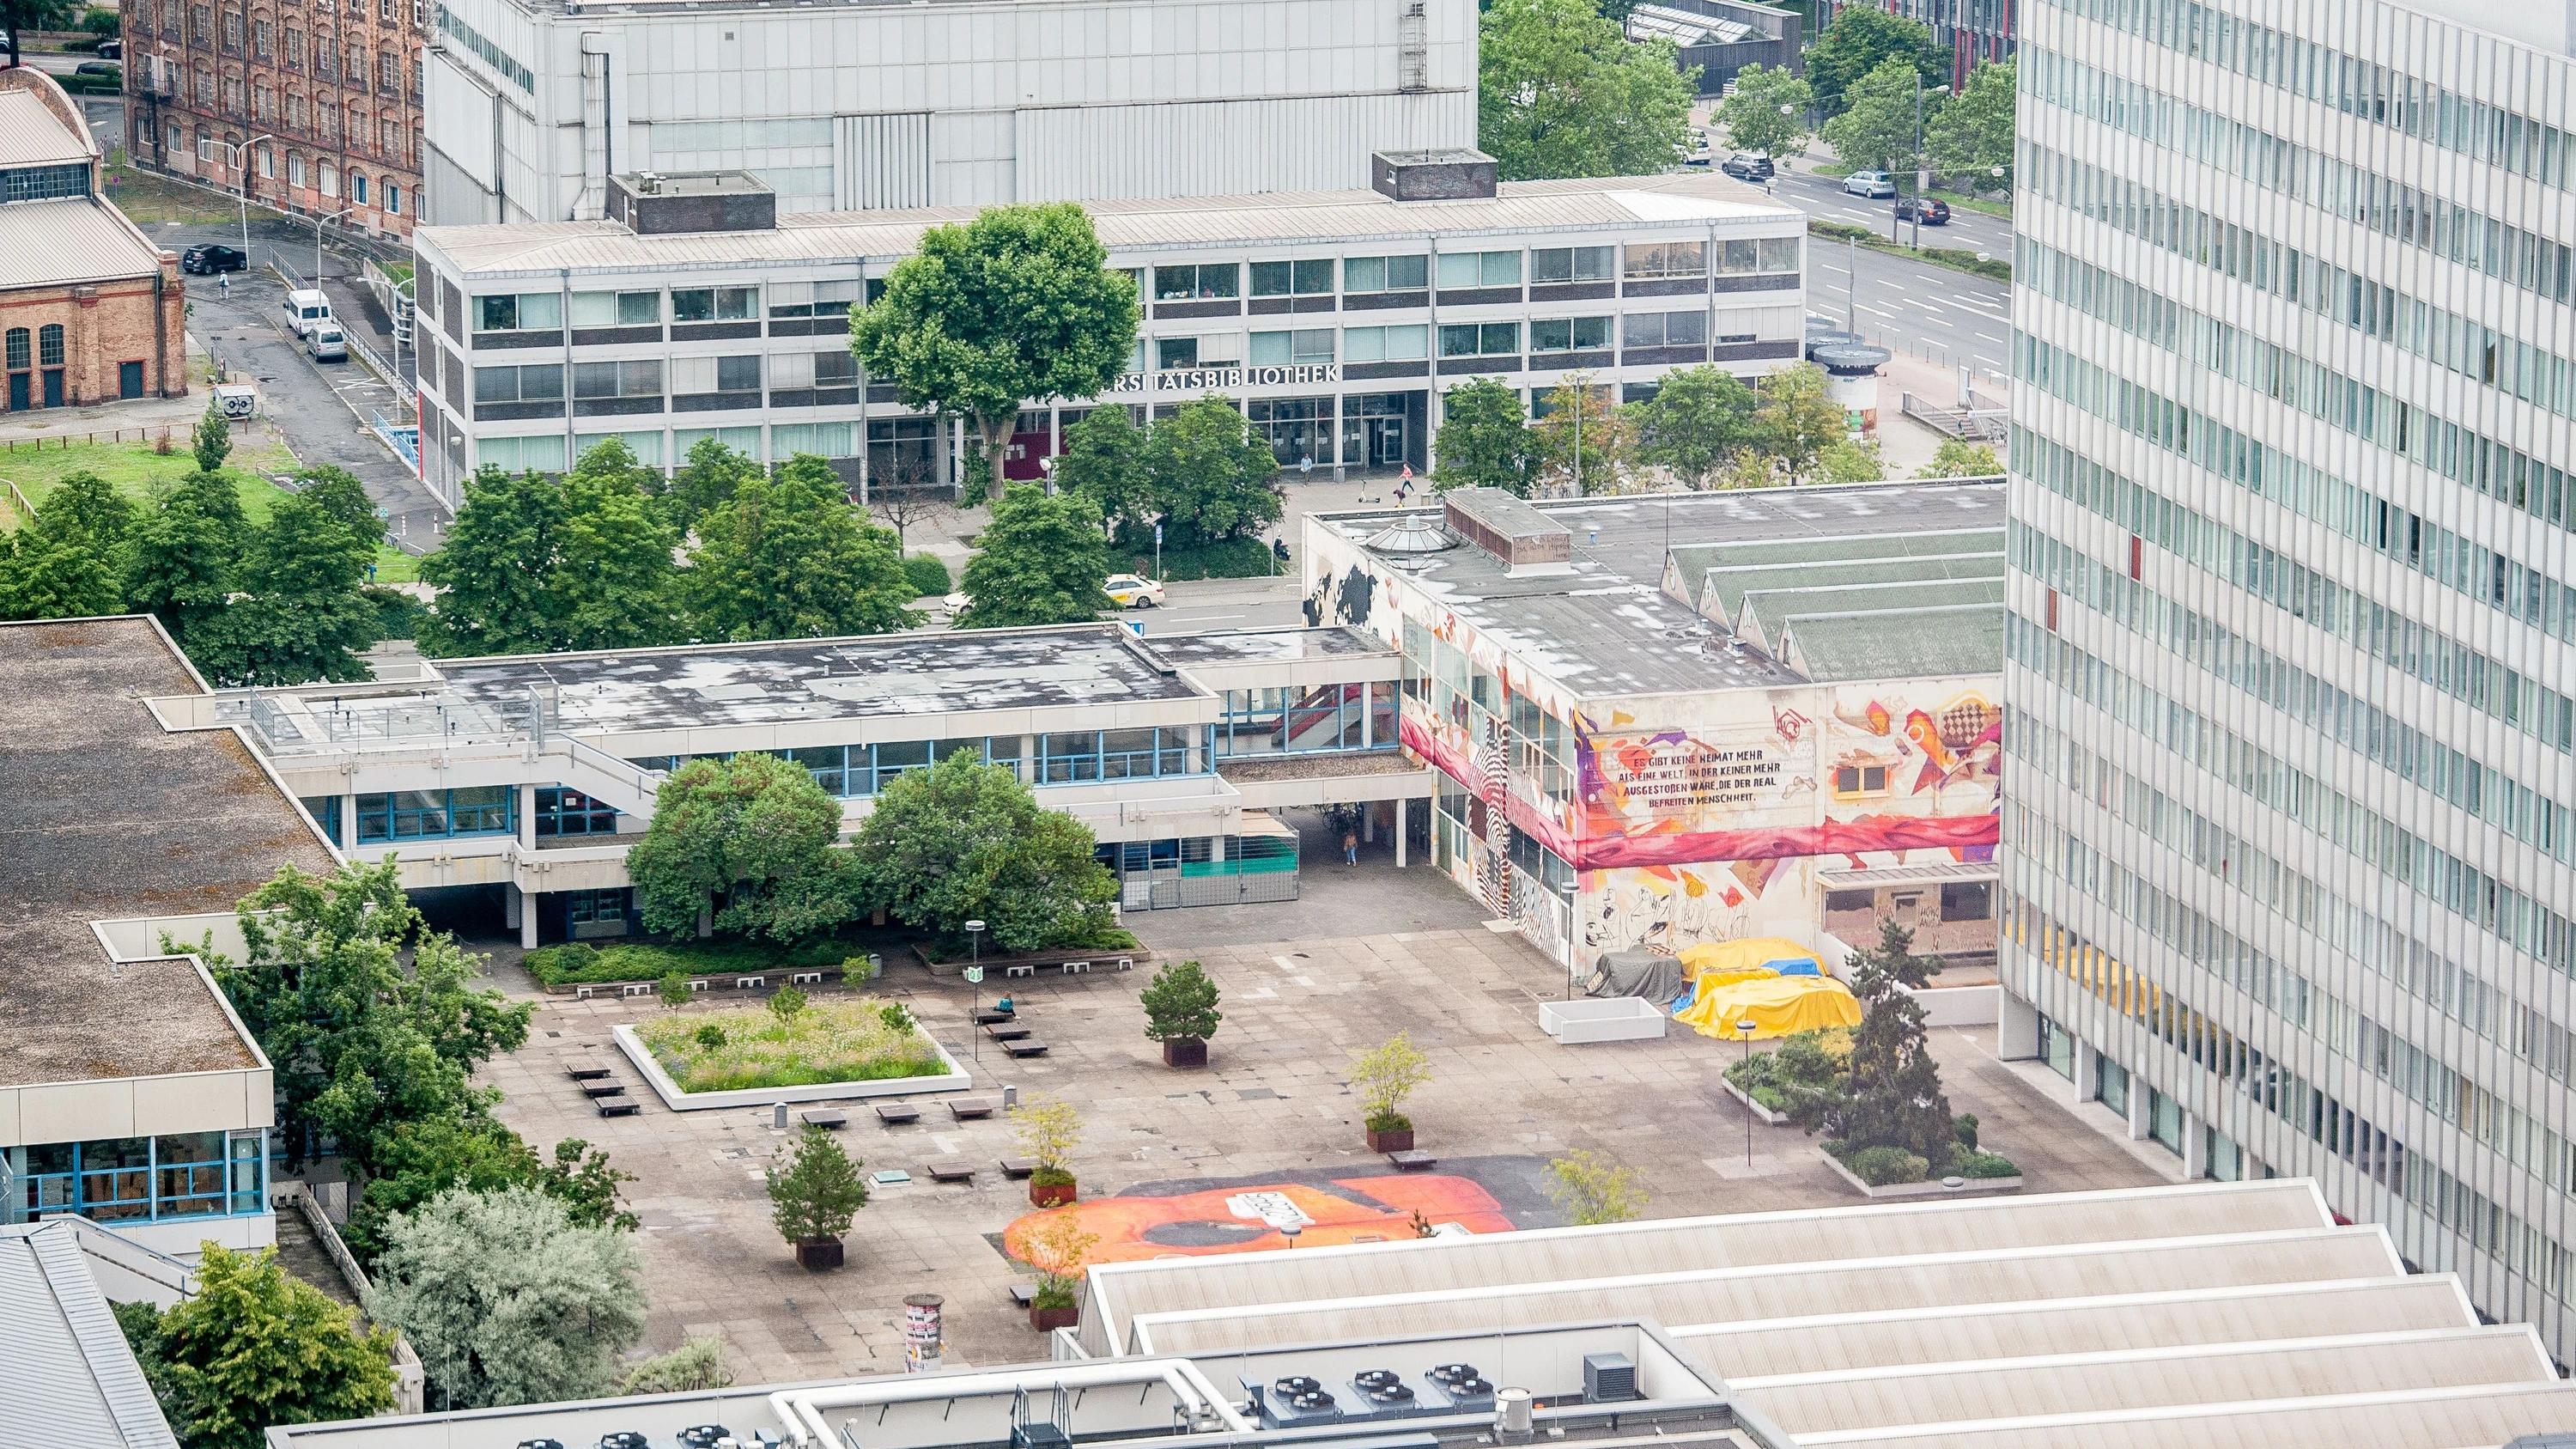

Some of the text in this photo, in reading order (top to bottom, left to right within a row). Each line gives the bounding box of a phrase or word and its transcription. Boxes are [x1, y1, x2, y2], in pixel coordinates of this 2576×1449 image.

[1634, 750, 1763, 767] ES GIBT KEINE HEIMAT MEHR
[1619, 773, 1635, 782] ALS
[1637, 771, 1656, 782] EINE
[1689, 769, 1698, 777] IN
[1701, 767, 1717, 776] DER
[1720, 765, 1752, 775] KEINER
[1753, 763, 1781, 773] MEHR
[1735, 779, 1751, 788] DER
[1753, 777, 1777, 787] REAL
[1649, 793, 1757, 808] BEFREITEN MENSCHHEIT.
